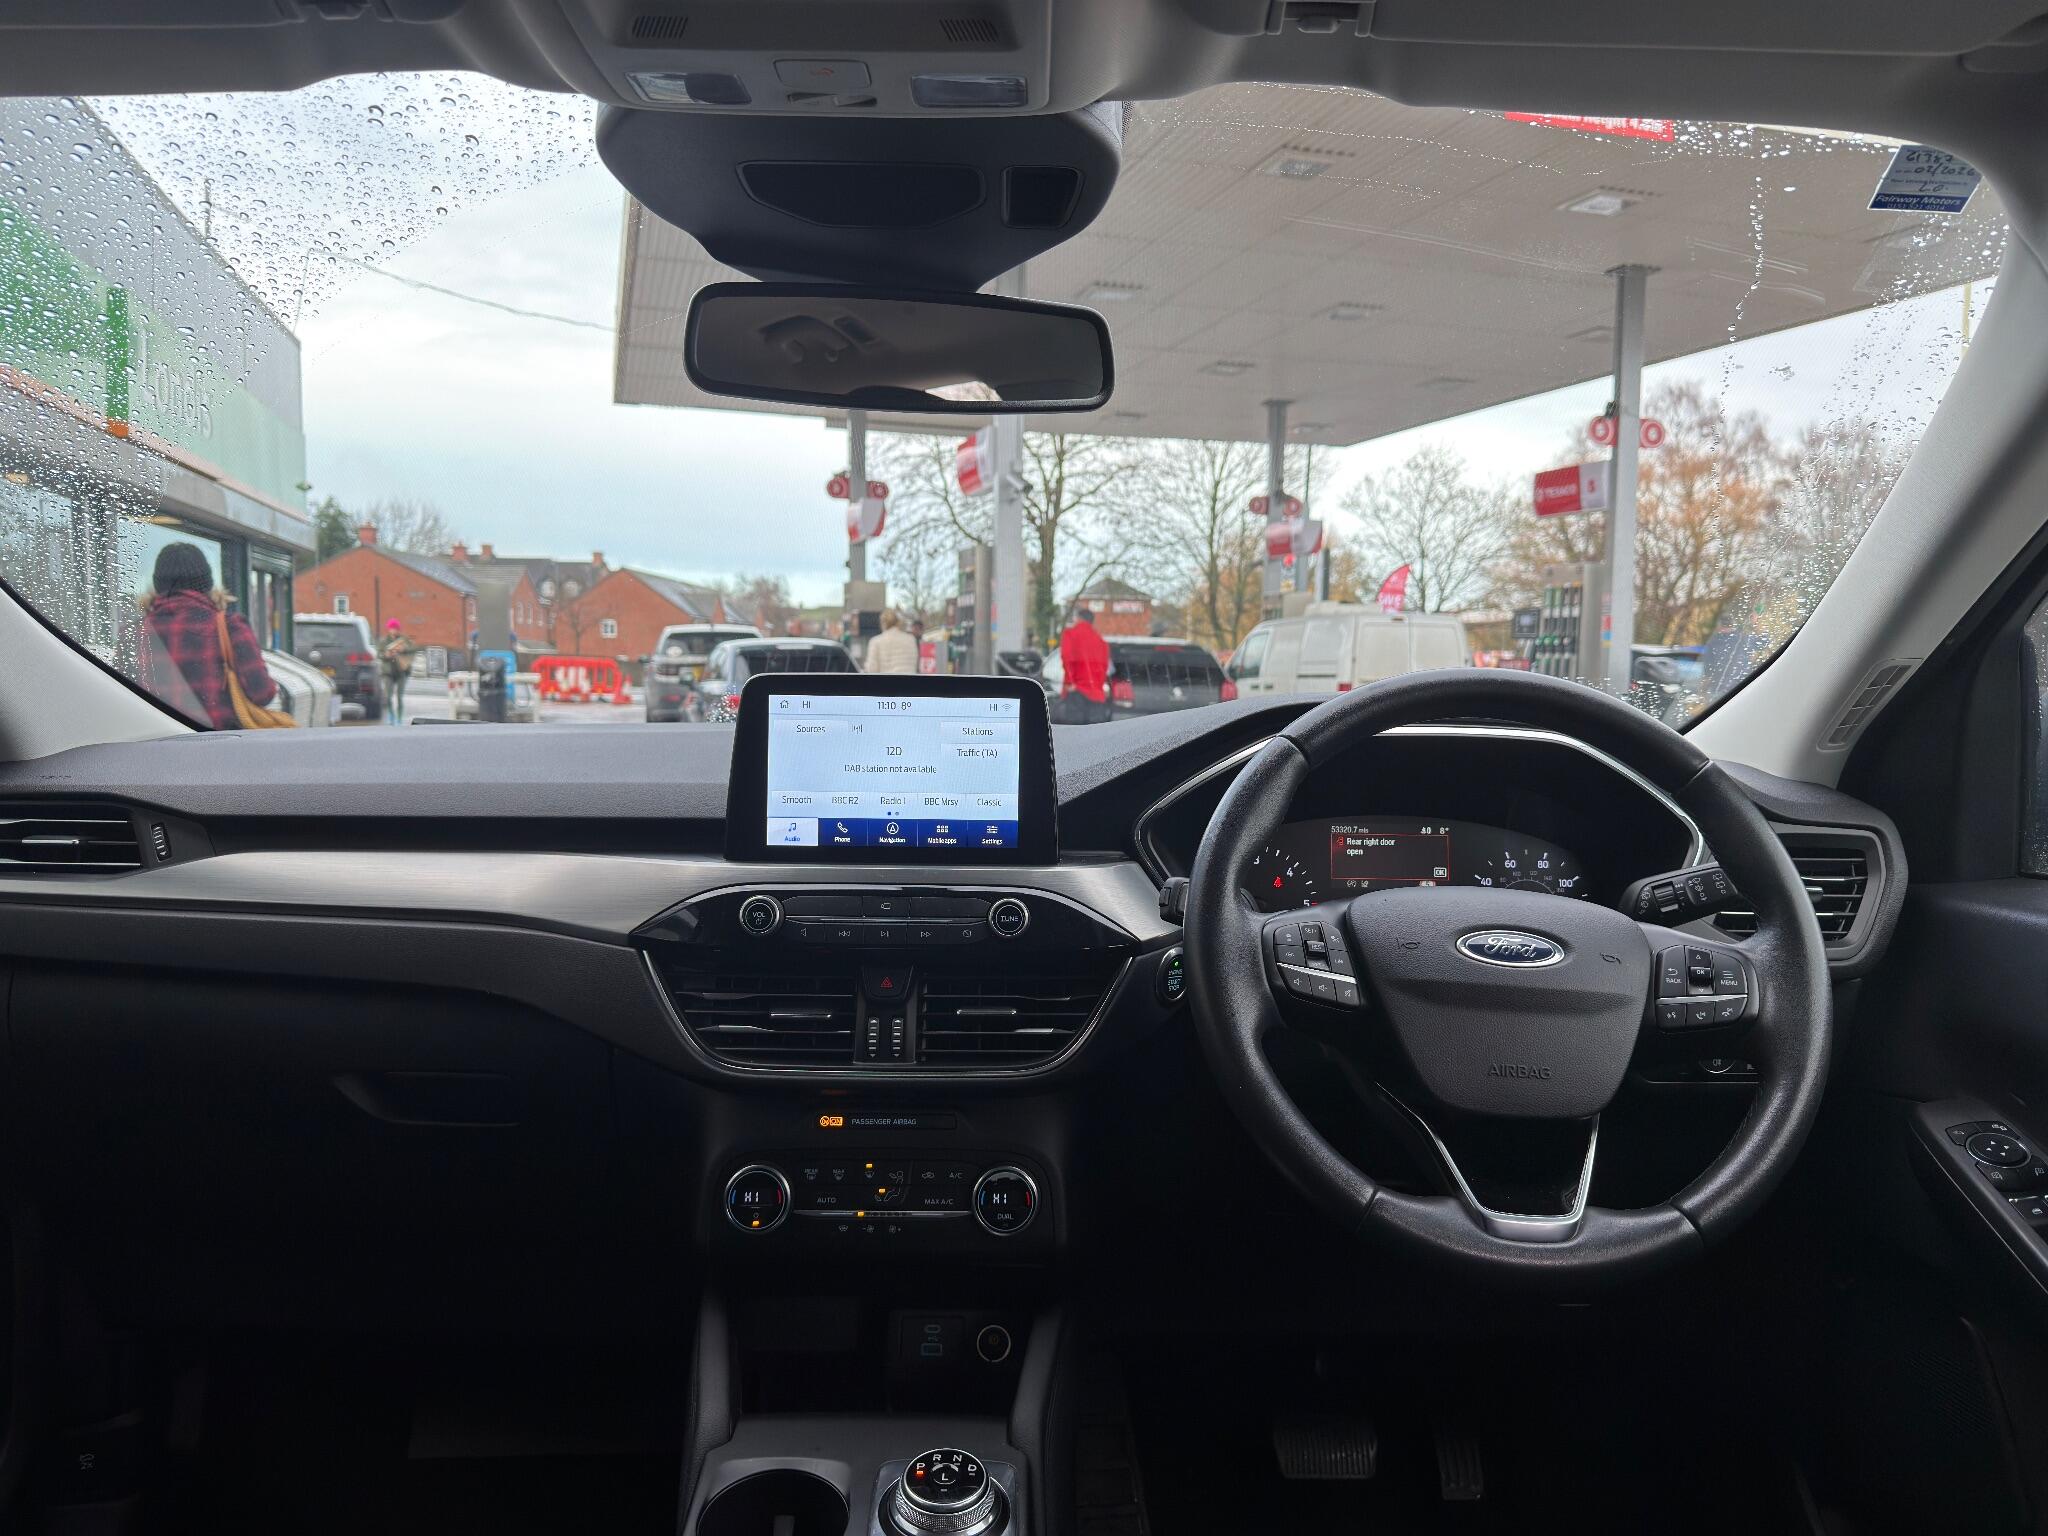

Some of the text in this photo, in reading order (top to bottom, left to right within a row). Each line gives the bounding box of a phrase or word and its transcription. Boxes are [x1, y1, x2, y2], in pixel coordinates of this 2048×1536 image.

[802, 700, 812, 709] HI
[877, 701, 896, 710] 11:10
[796, 724, 826, 733] Sources
[962, 727, 994, 736] Stations
[885, 746, 903, 756] 12D
[956, 748, 980, 758] Traffic
[844, 764, 937, 774] DAB station not available
[781, 795, 812, 805] Smooth
[831, 796, 859, 805] BBC R2
[880, 796, 900, 805] Radio
[924, 797, 940, 806] BBC
[976, 798, 1002, 807] Classic
[879, 836, 906, 844] Navigation
[982, 838, 1003, 846] Settings
[1346, 838, 1362, 846] Rear
[1364, 838, 1379, 846] right
[1346, 848, 1364, 857] open
[1504, 860, 1516, 868] 60
[1537, 860, 1549, 869] 80
[1286, 867, 1294, 877] 4
[1480, 878, 1492, 886] 40
[1558, 879, 1573, 888] 100
[1484, 936, 1537, 959] Ford
[1488, 1063, 1553, 1080] AIRBAG
[968, 1464, 978, 1472] D
